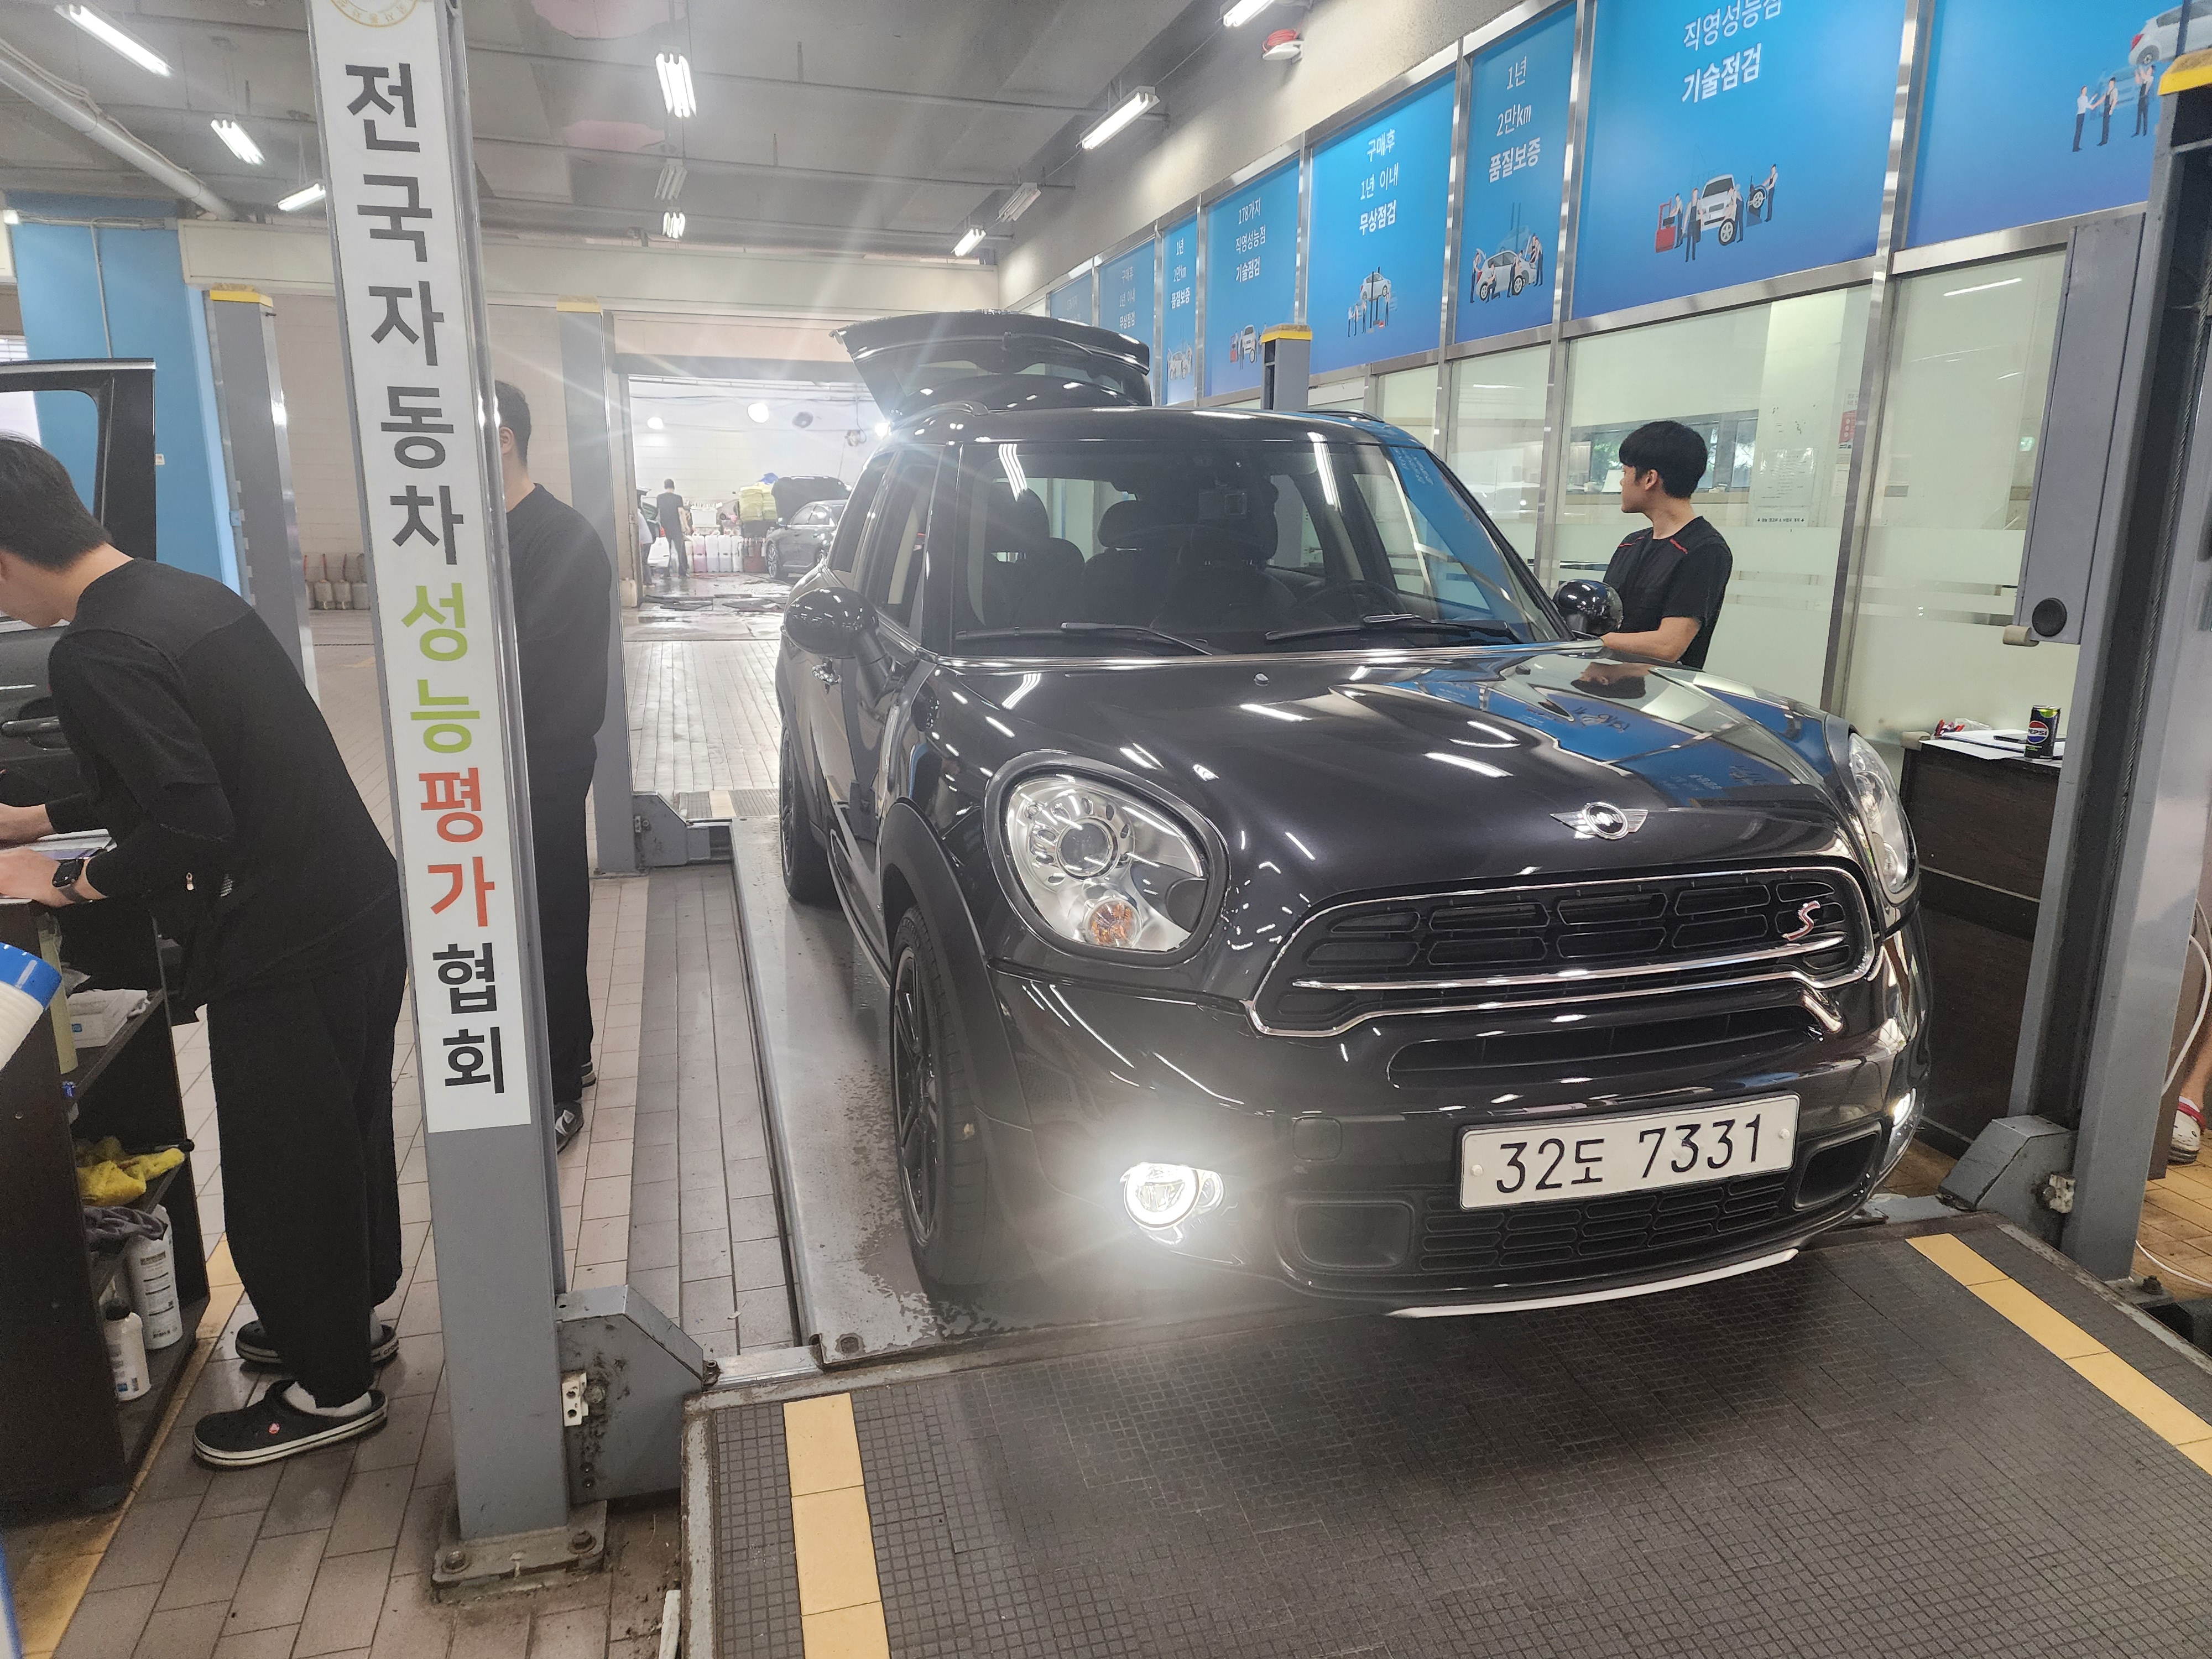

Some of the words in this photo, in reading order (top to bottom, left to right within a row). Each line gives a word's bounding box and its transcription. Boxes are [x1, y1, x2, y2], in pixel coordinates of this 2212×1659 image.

[1506, 55, 1527, 90] 1년
[1682, 42, 1762, 103] 기술점검
[1496, 103, 1532, 137] 2만km
[1367, 128, 1395, 162] 구매후
[1489, 137, 1541, 183] 품질보증
[1360, 173, 1375, 200] 1년
[1380, 162, 1399, 191] 이내
[1238, 197, 1261, 225] 178가지
[1359, 199, 1396, 236] 무상점검
[1176, 237, 1184, 255] 1년
[1235, 224, 1266, 254] 직영성능점
[1235, 255, 1260, 283] 기술점검
[1171, 286, 1190, 309] 품질보증
[1496, 1138, 1605, 1194] 32도
[1639, 1113, 1761, 1178] 7331
